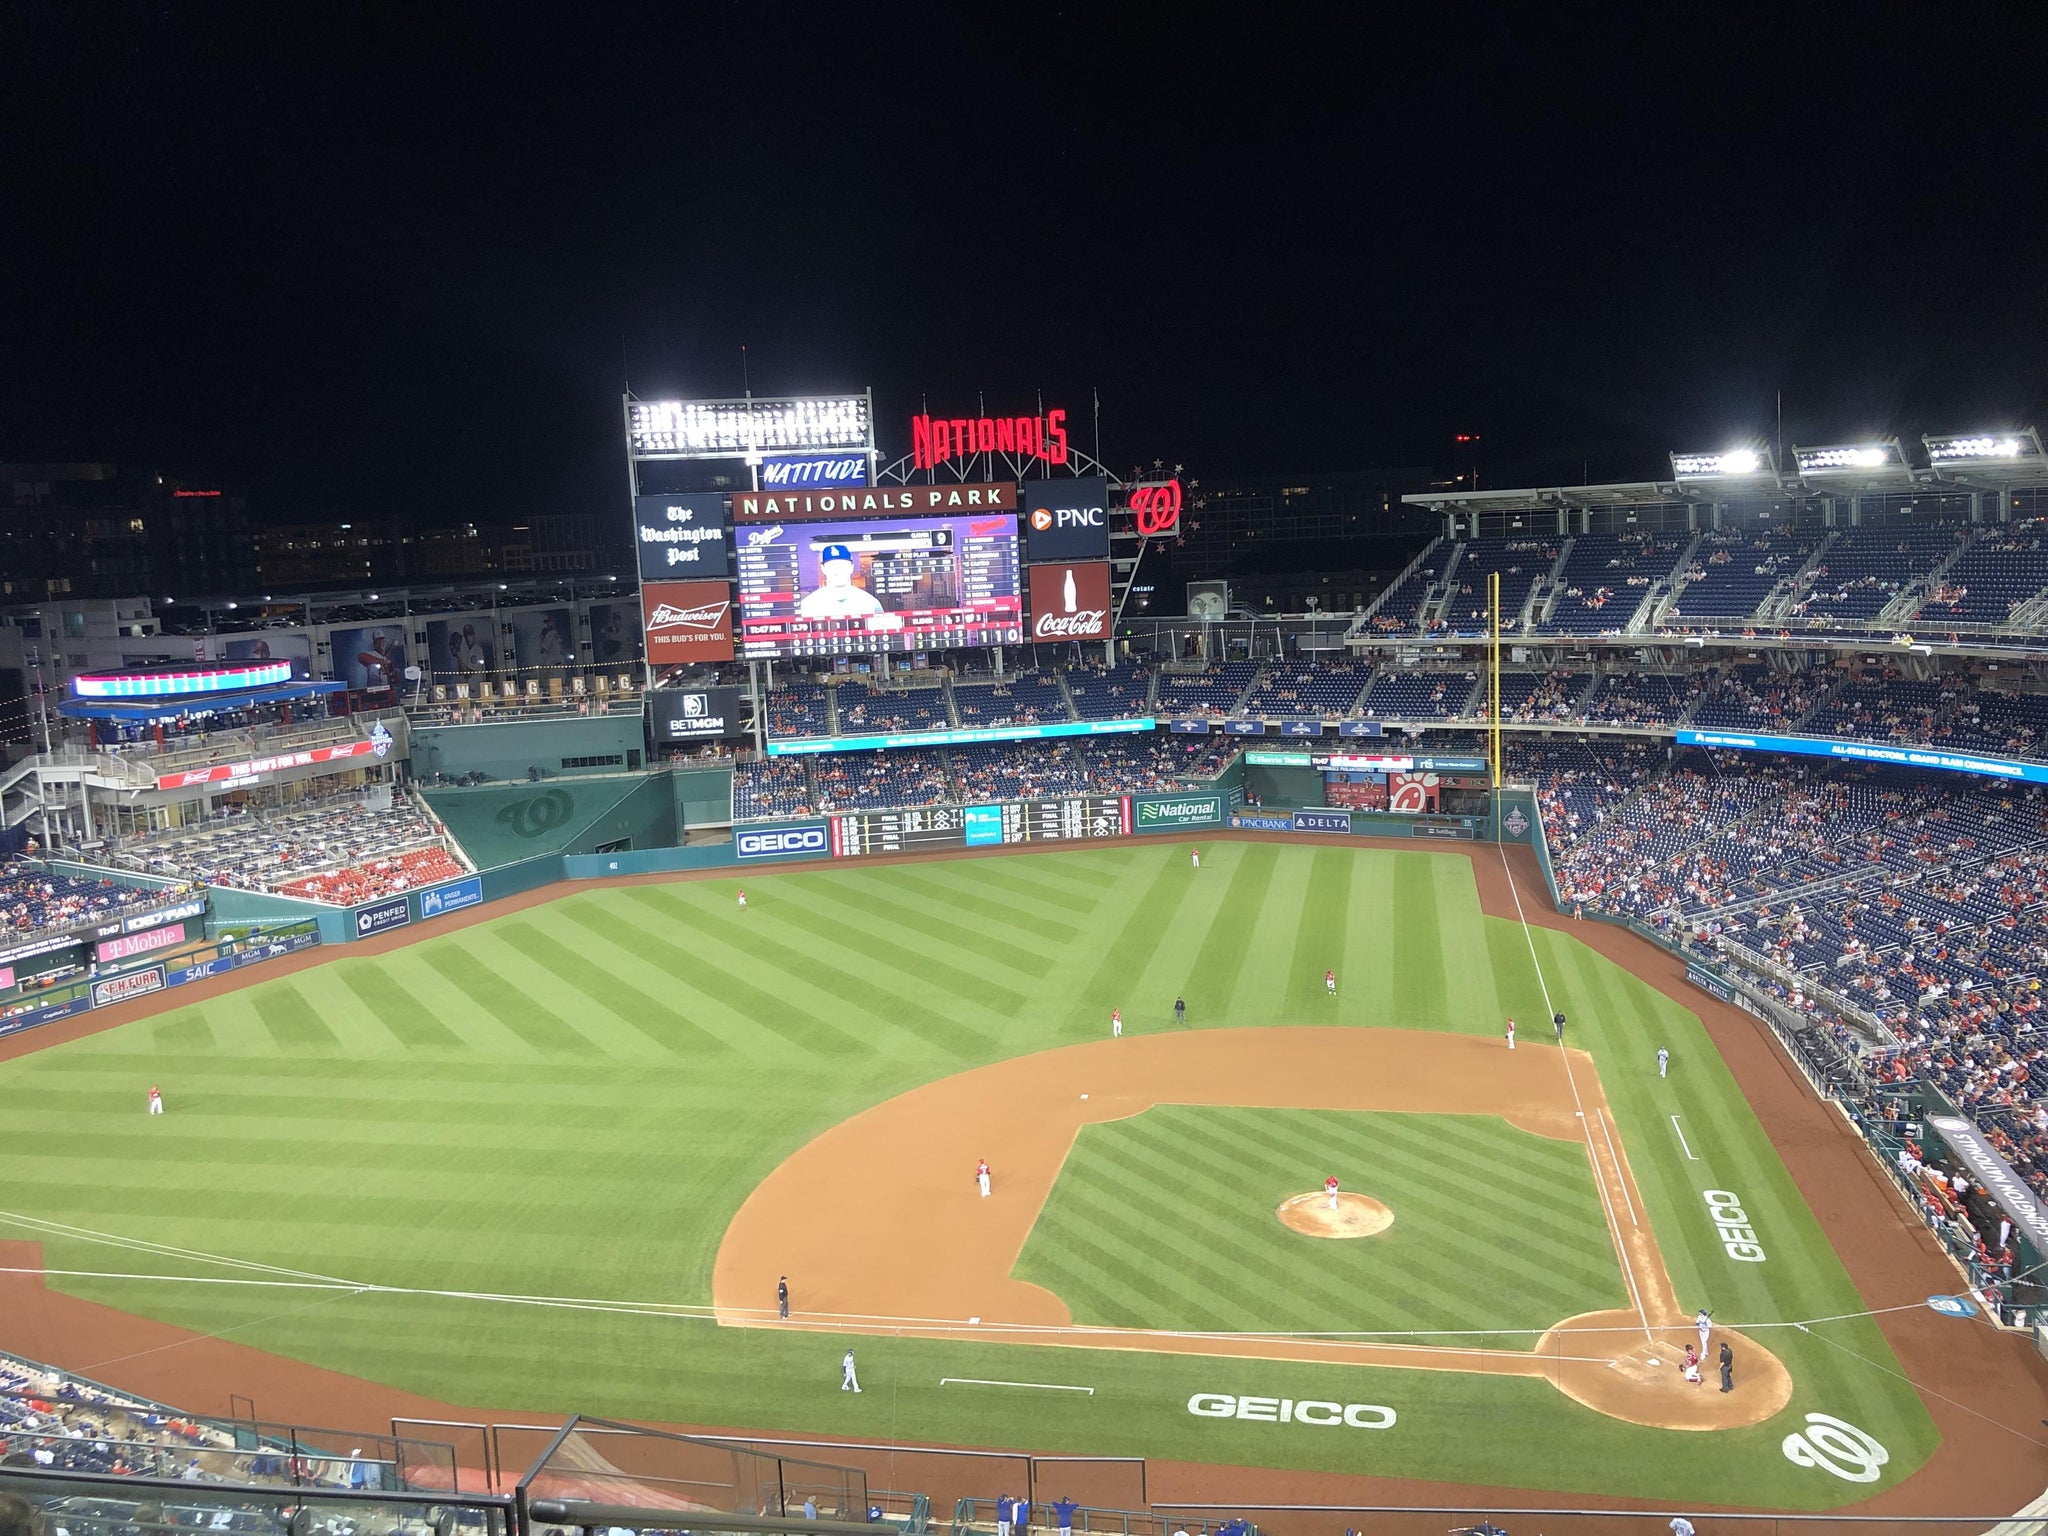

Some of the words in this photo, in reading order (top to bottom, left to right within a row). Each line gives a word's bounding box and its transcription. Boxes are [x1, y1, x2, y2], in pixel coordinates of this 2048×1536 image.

[913, 409, 1067, 469] NATIONALS
[764, 459, 866, 485] NATITUDE
[743, 491, 913, 514] NATIONALS
[930, 488, 1002, 507] PARK
[667, 506, 693, 522] The
[1056, 508, 1104, 527] PNC
[641, 525, 722, 544] Washington
[667, 547, 699, 566] Post
[652, 608, 720, 623] Budweiser
[672, 634, 693, 643] BUD'S
[695, 634, 708, 642] FOR
[710, 633, 726, 641] YOU.
[1008, 629, 1017, 641] 0
[436, 681, 538, 699] SWING
[671, 717, 724, 730] BETMGM
[1832, 745, 1866, 757] ALL-STAR
[1909, 753, 1940, 764] GRAND
[1941, 756, 1964, 767] SLAM
[231, 765, 250, 776] THIS
[1158, 801, 1214, 817] National
[1242, 818, 1263, 827] PNC
[1263, 819, 1288, 829] BANK
[1308, 818, 1348, 828] DELTA
[740, 831, 824, 852] GEICO
[373, 905, 406, 921] PENFED
[98, 924, 120, 936] 11:47
[295, 934, 312, 946] MGM
[242, 949, 261, 961] MGM
[186, 962, 215, 980] SAIC
[1953, 1134, 2011, 1192] NATIONALS
[1703, 1190, 1766, 1261] GEICO
[1188, 1393, 1398, 1430] GEICO
